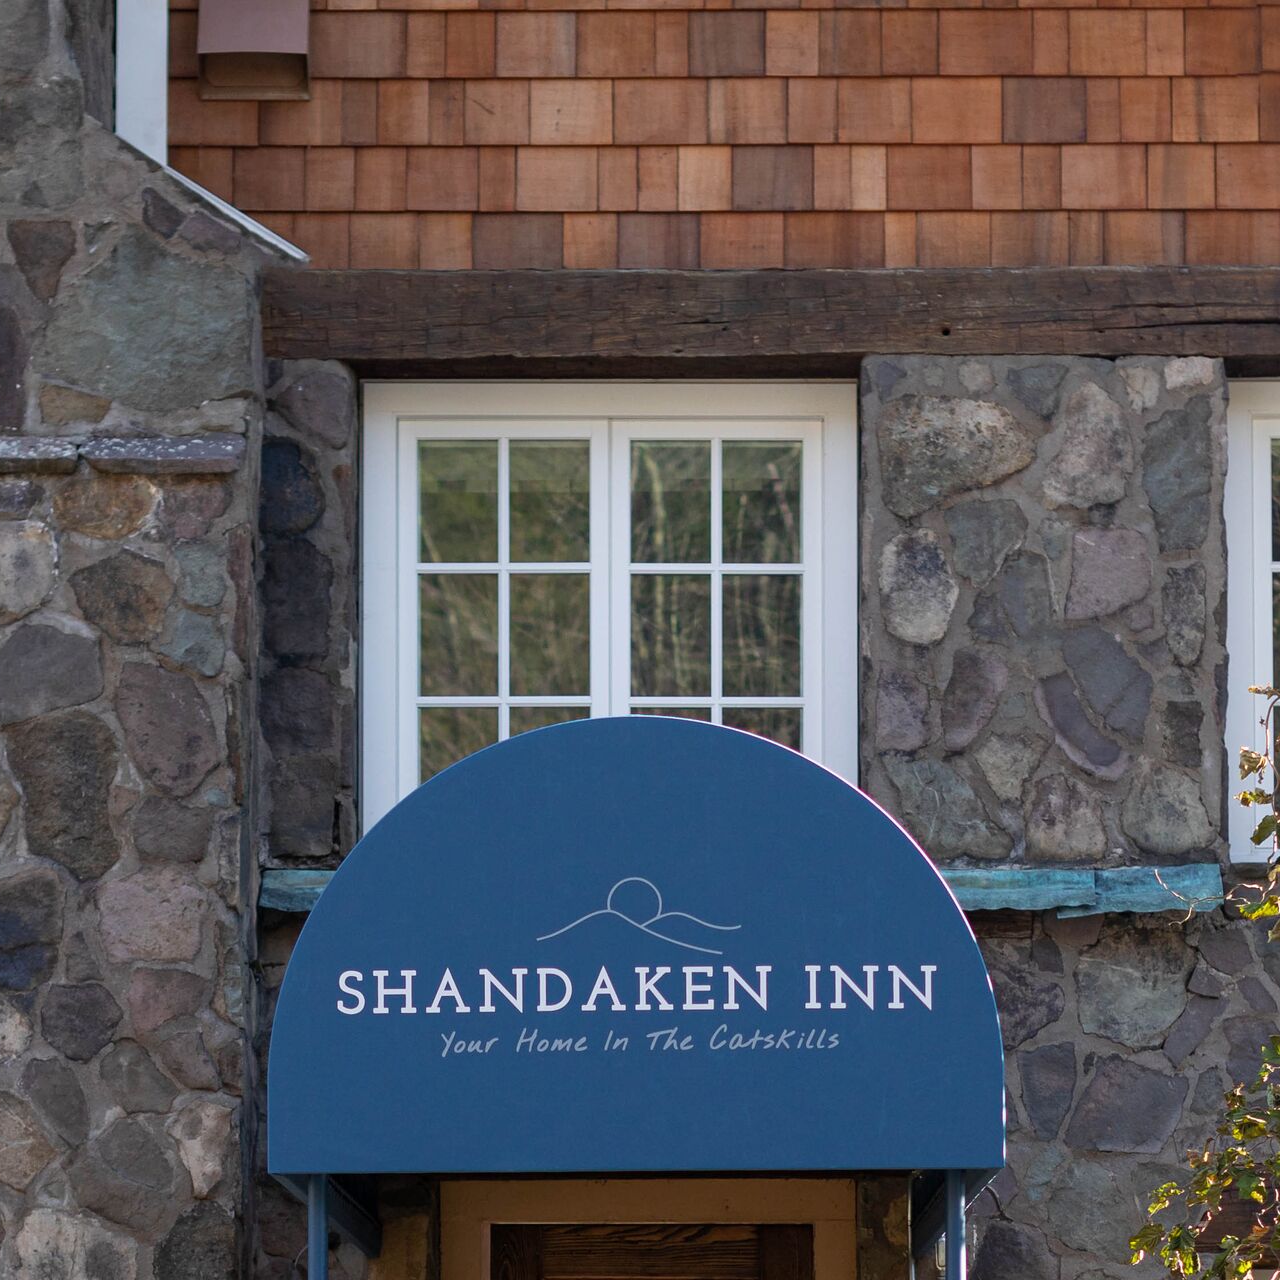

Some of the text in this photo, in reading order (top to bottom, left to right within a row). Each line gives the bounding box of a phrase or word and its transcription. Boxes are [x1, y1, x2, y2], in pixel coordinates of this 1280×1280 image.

[336, 964, 938, 1015] SHANDAKEN INN
[440, 1030, 500, 1058] Your
[515, 1027, 589, 1054] Home
[603, 1029, 629, 1051] In
[646, 1026, 694, 1051] The
